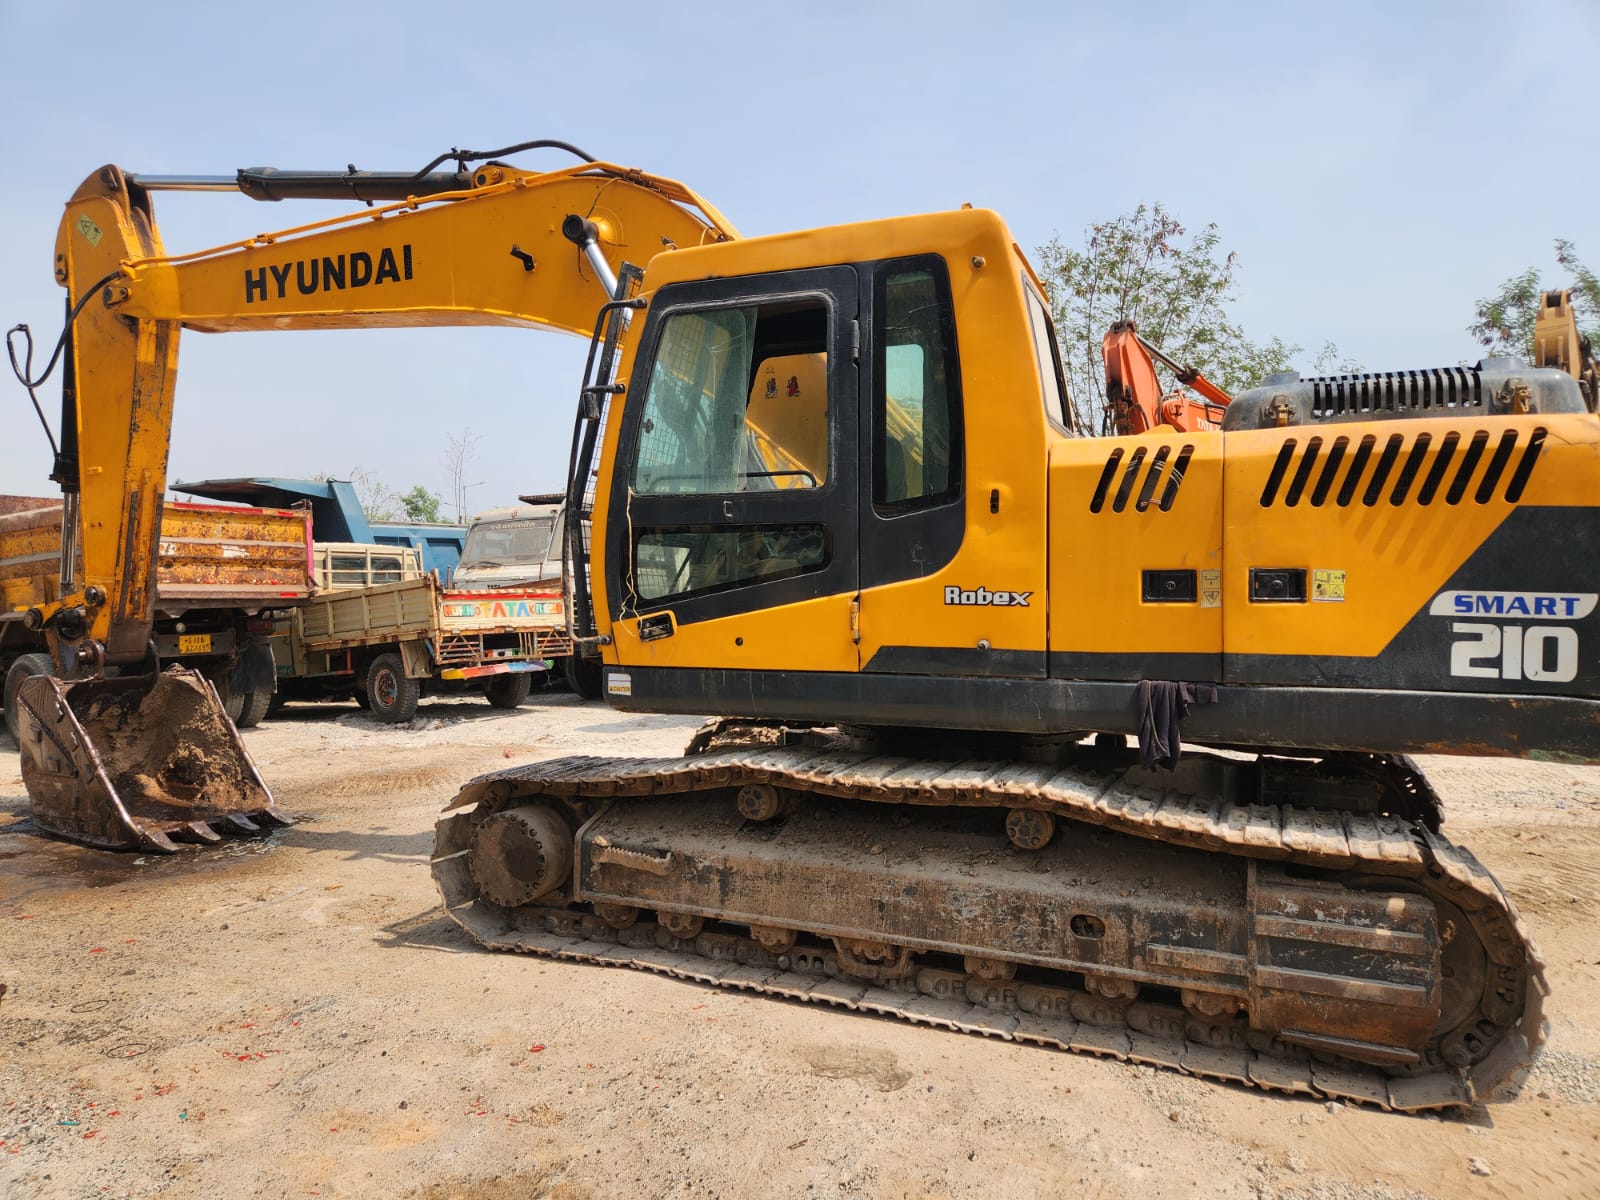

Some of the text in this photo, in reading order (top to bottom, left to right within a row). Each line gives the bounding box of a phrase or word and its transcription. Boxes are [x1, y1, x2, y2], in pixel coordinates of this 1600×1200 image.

[245, 244, 413, 304] HYUNDAI
[944, 586, 1034, 606] Robex
[1454, 595, 1580, 616] SMART
[480, 601, 530, 618] TATA
[1450, 622, 1579, 683] 210
